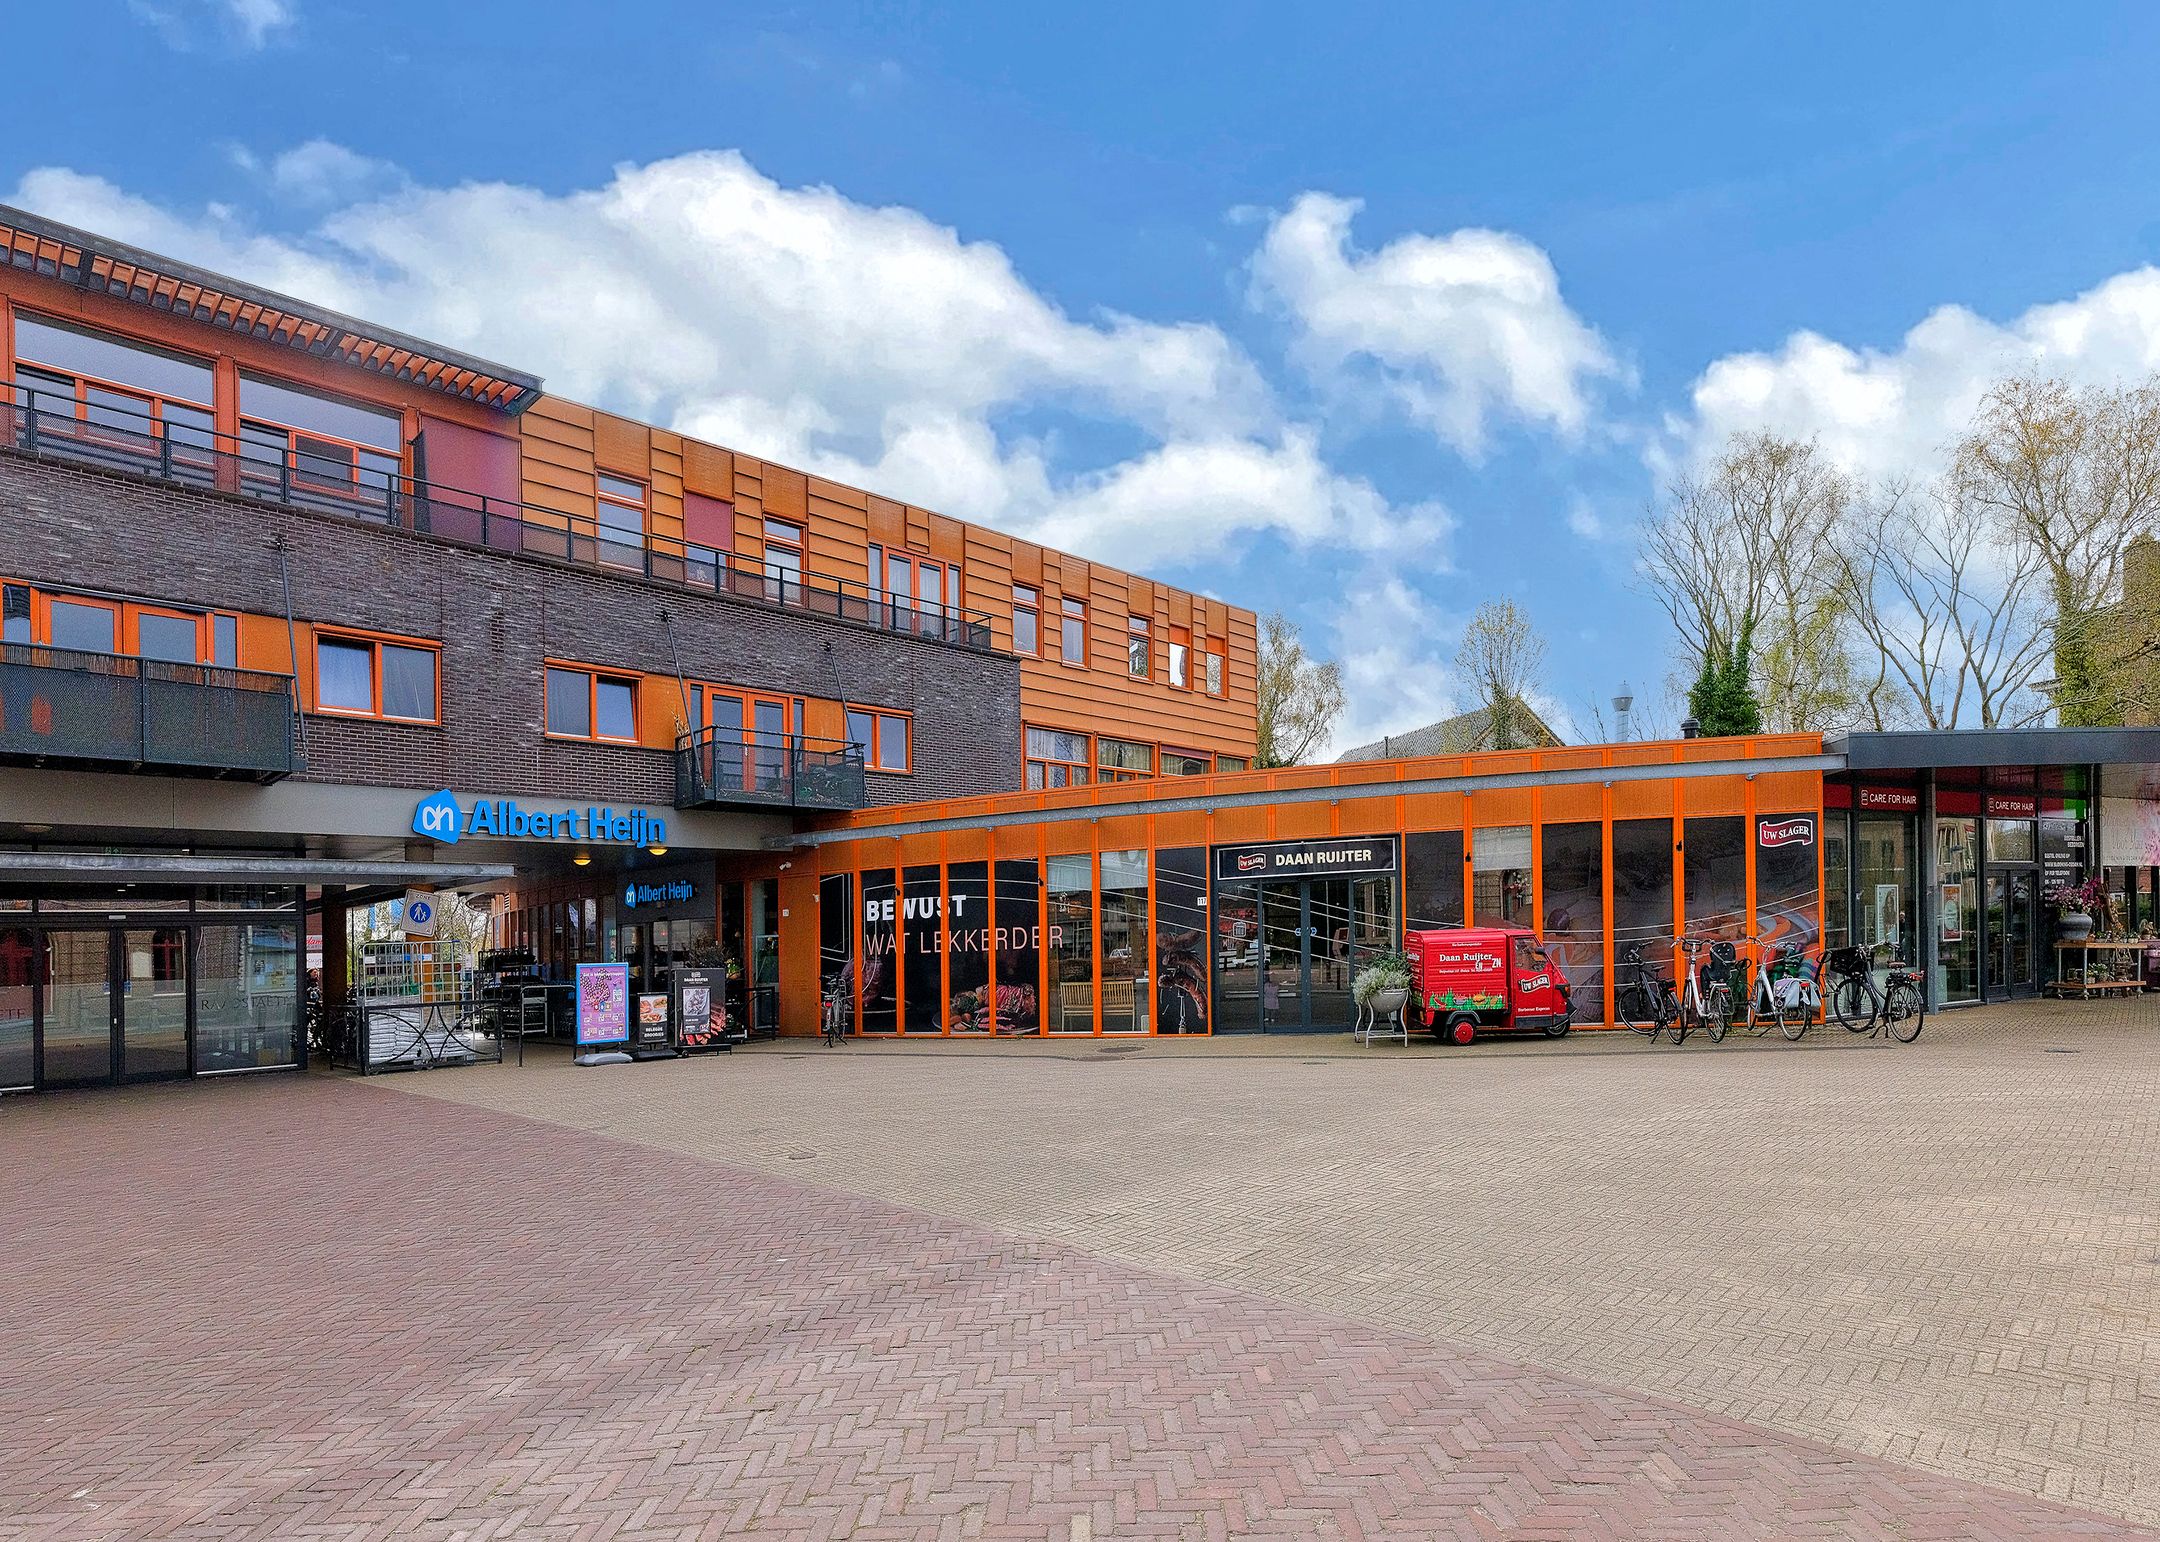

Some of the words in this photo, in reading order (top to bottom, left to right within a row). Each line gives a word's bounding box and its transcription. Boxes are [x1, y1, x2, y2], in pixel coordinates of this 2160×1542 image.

[1870, 793, 1886, 804] CARE
[1888, 794, 1901, 804] FOR
[1902, 795, 1917, 805] HAIR
[1995, 801, 2010, 810] CARE
[2010, 802, 2021, 811] FOR
[2021, 802, 2034, 811] HAIR
[468, 800, 581, 840] Albert
[588, 807, 667, 849] Heijn
[1763, 829, 1778, 840] UW
[1778, 825, 1810, 839] SLAGER
[1248, 857, 1264, 866] SLAGER
[1275, 853, 1314, 866] DAAN
[1317, 849, 1372, 864] RUIJTER
[415, 893, 431, 901] ZONE
[637, 884, 667, 903] Albert
[668, 880, 693, 902] Heijn
[866, 894, 967, 922] BEWUST
[866, 932, 911, 956] WAT
[920, 925, 1064, 954] LEKKERDER
[1439, 954, 1460, 962] Daan
[1463, 953, 1493, 963] Ruijter
[1523, 982, 1532, 990] UW
[1532, 976, 1549, 988] SLAGER
